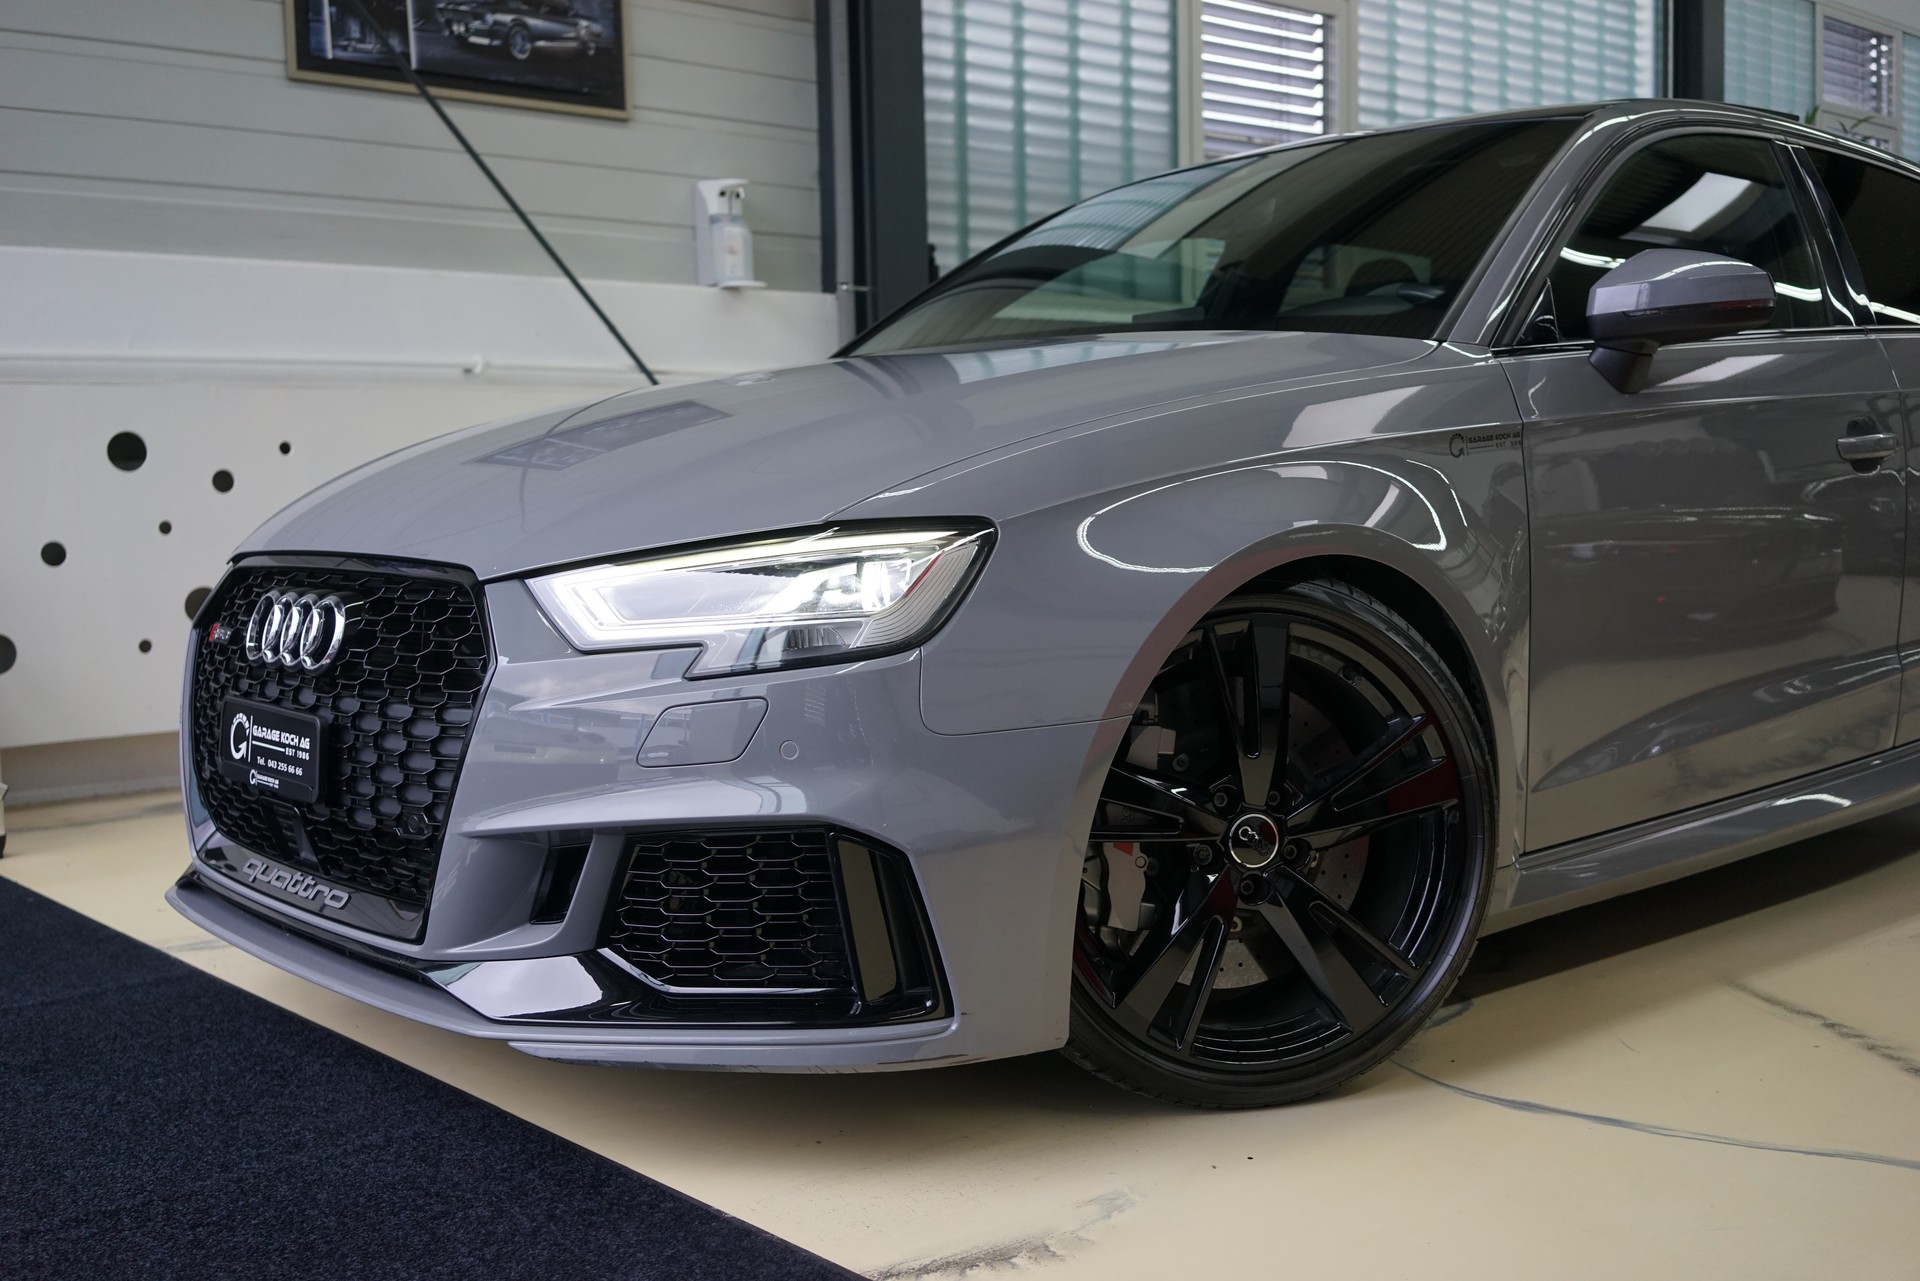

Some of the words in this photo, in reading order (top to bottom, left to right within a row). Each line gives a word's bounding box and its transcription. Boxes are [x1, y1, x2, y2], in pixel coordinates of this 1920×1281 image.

[1469, 434, 1493, 443] GARAGE
[252, 725, 280, 742] GARAGE
[281, 731, 299, 746] KOCH
[299, 737, 310, 749] AG
[286, 747, 295, 756] EST
[296, 750, 309, 760] 1986
[257, 756, 265, 766] Tel.
[267, 759, 277, 769] 043
[278, 762, 287, 772] 255
[288, 765, 295, 774] 66
[295, 767, 303, 776] 66
[242, 858, 349, 909] quattro
